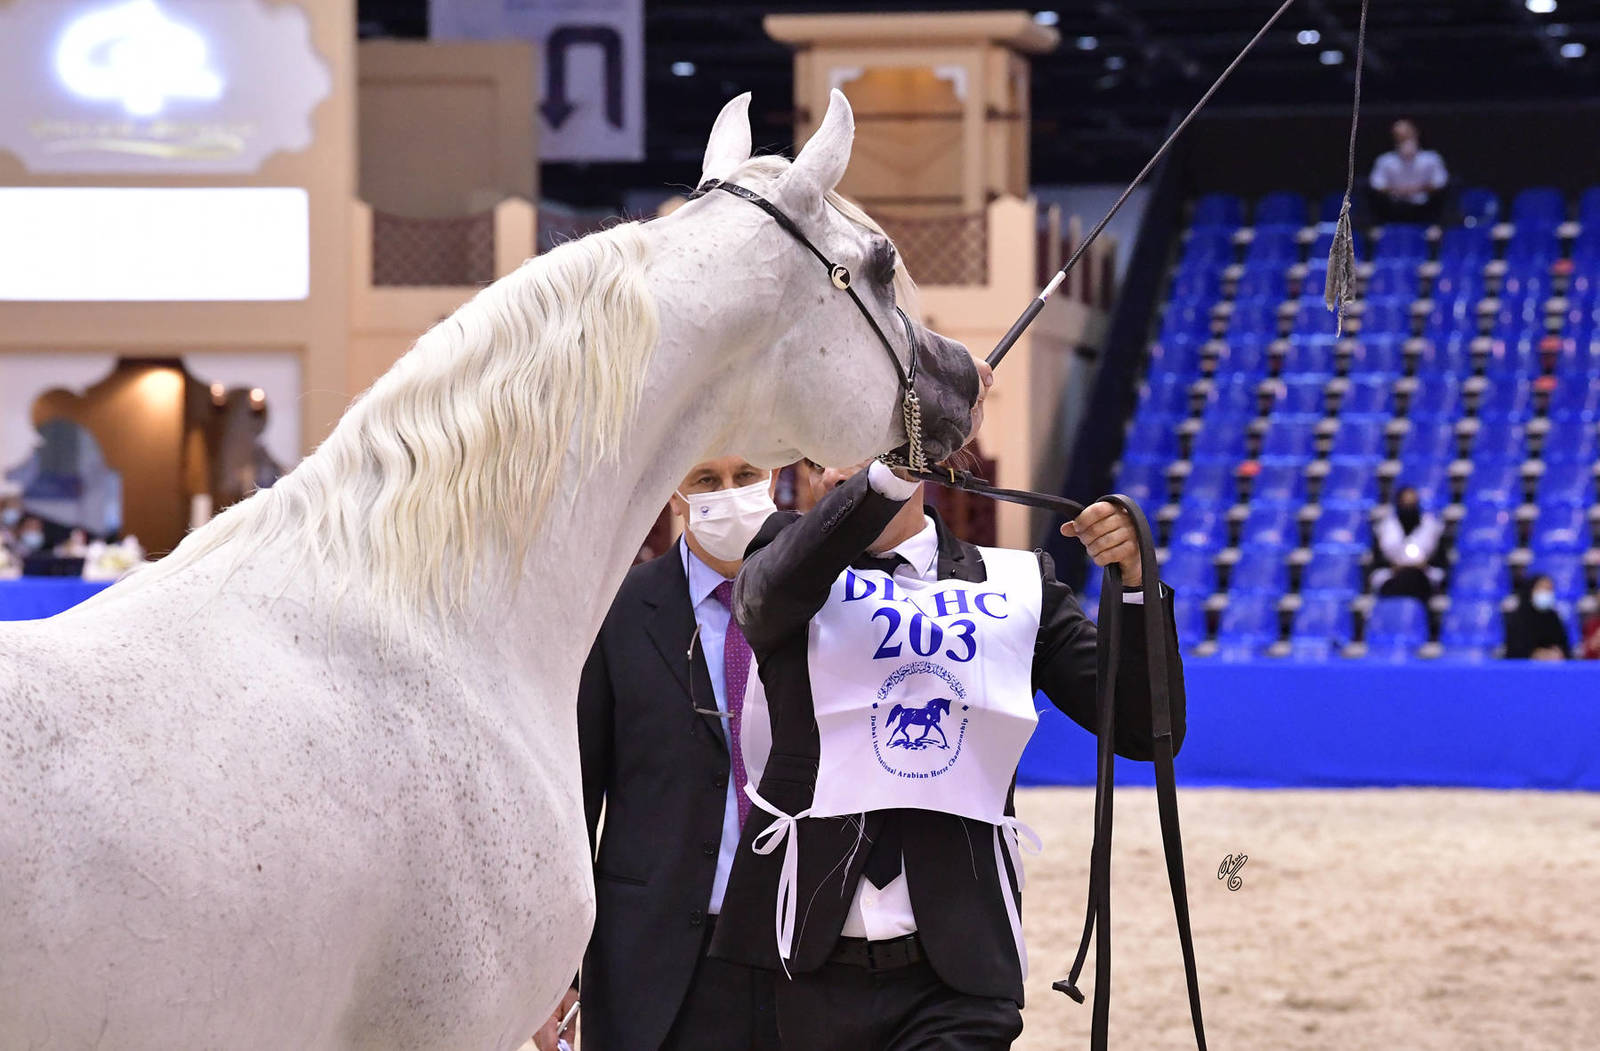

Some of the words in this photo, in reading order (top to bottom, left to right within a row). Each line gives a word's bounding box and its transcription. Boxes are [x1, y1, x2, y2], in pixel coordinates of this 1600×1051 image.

[841, 569, 1009, 619] DIHC
[871, 607, 977, 662] 203
[873, 740, 897, 775] International
[898, 770, 929, 779] Arabian
[930, 766, 949, 778] Horse
[948, 718, 969, 767] Championship
